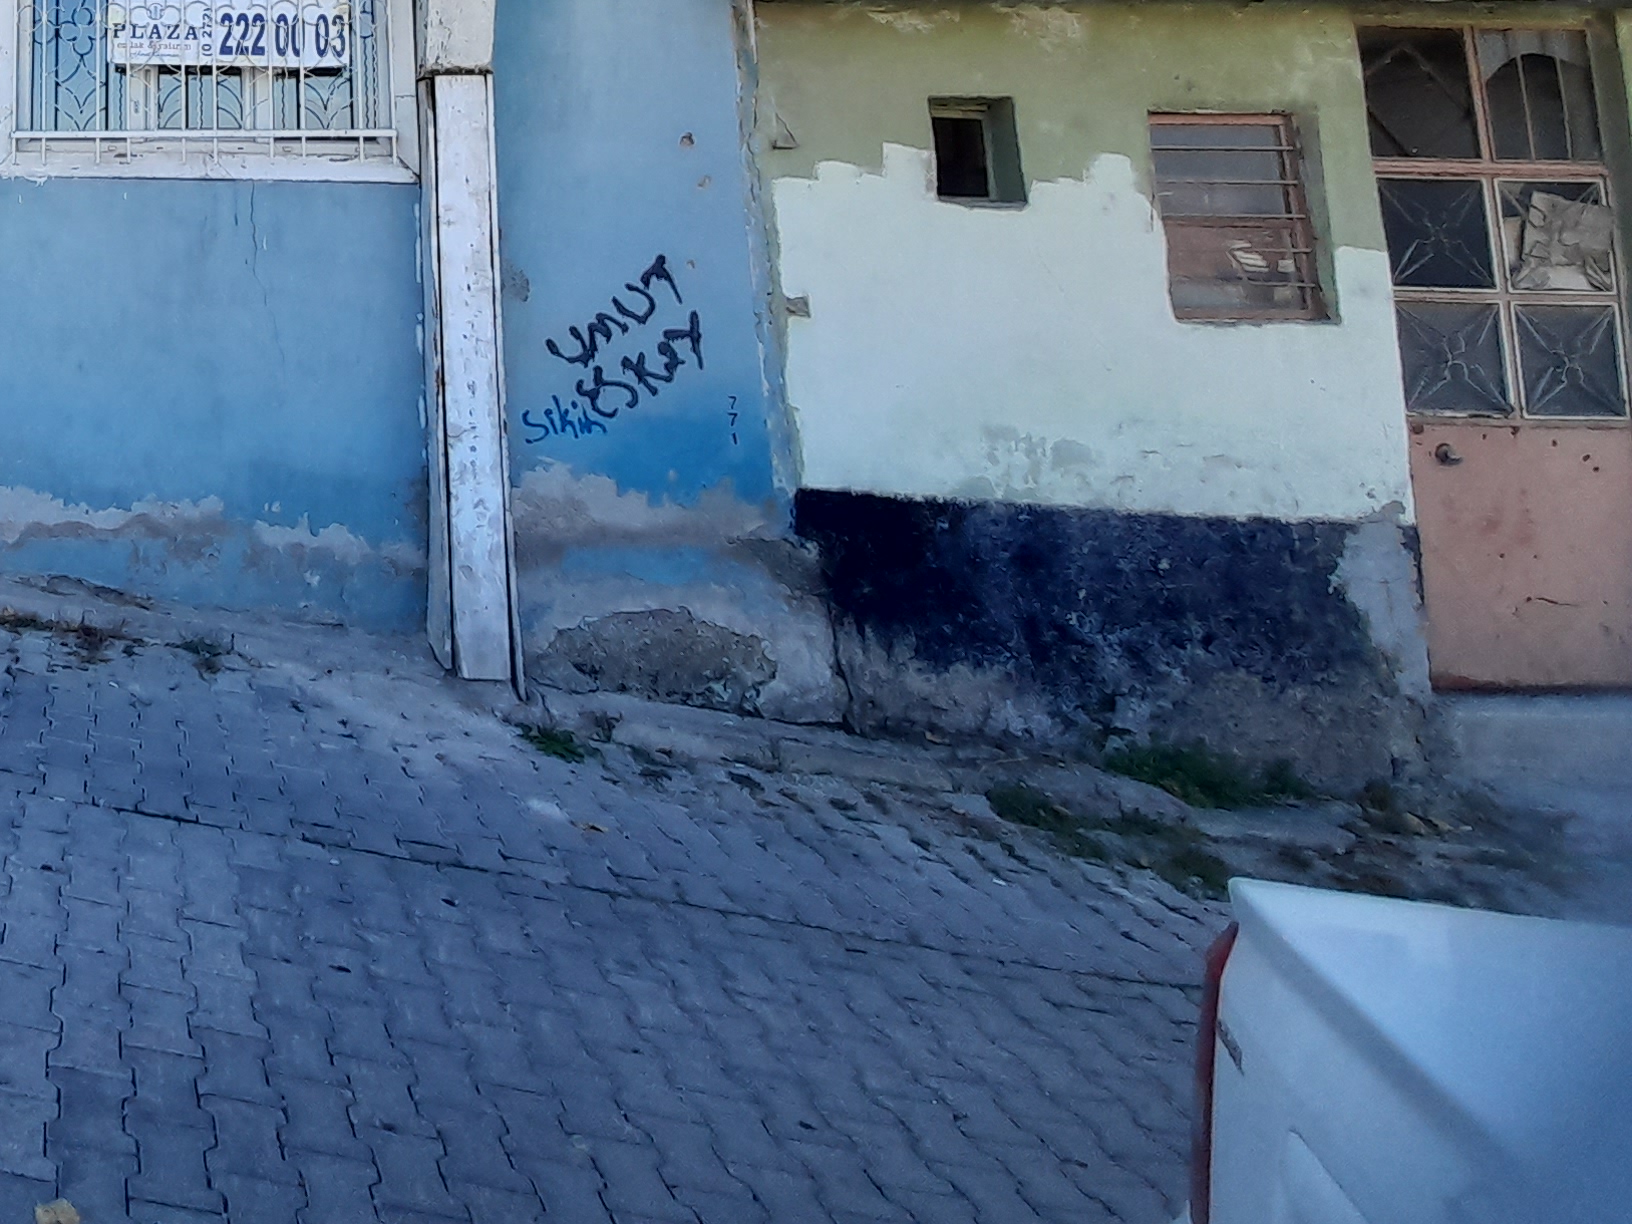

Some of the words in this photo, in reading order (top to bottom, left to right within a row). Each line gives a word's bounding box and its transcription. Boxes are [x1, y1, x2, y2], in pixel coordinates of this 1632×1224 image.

[112, 22, 199, 40] PLAZA
[219, 12, 266, 56] 222
[275, 12, 306, 58] 00
[315, 13, 346, 58] 03
